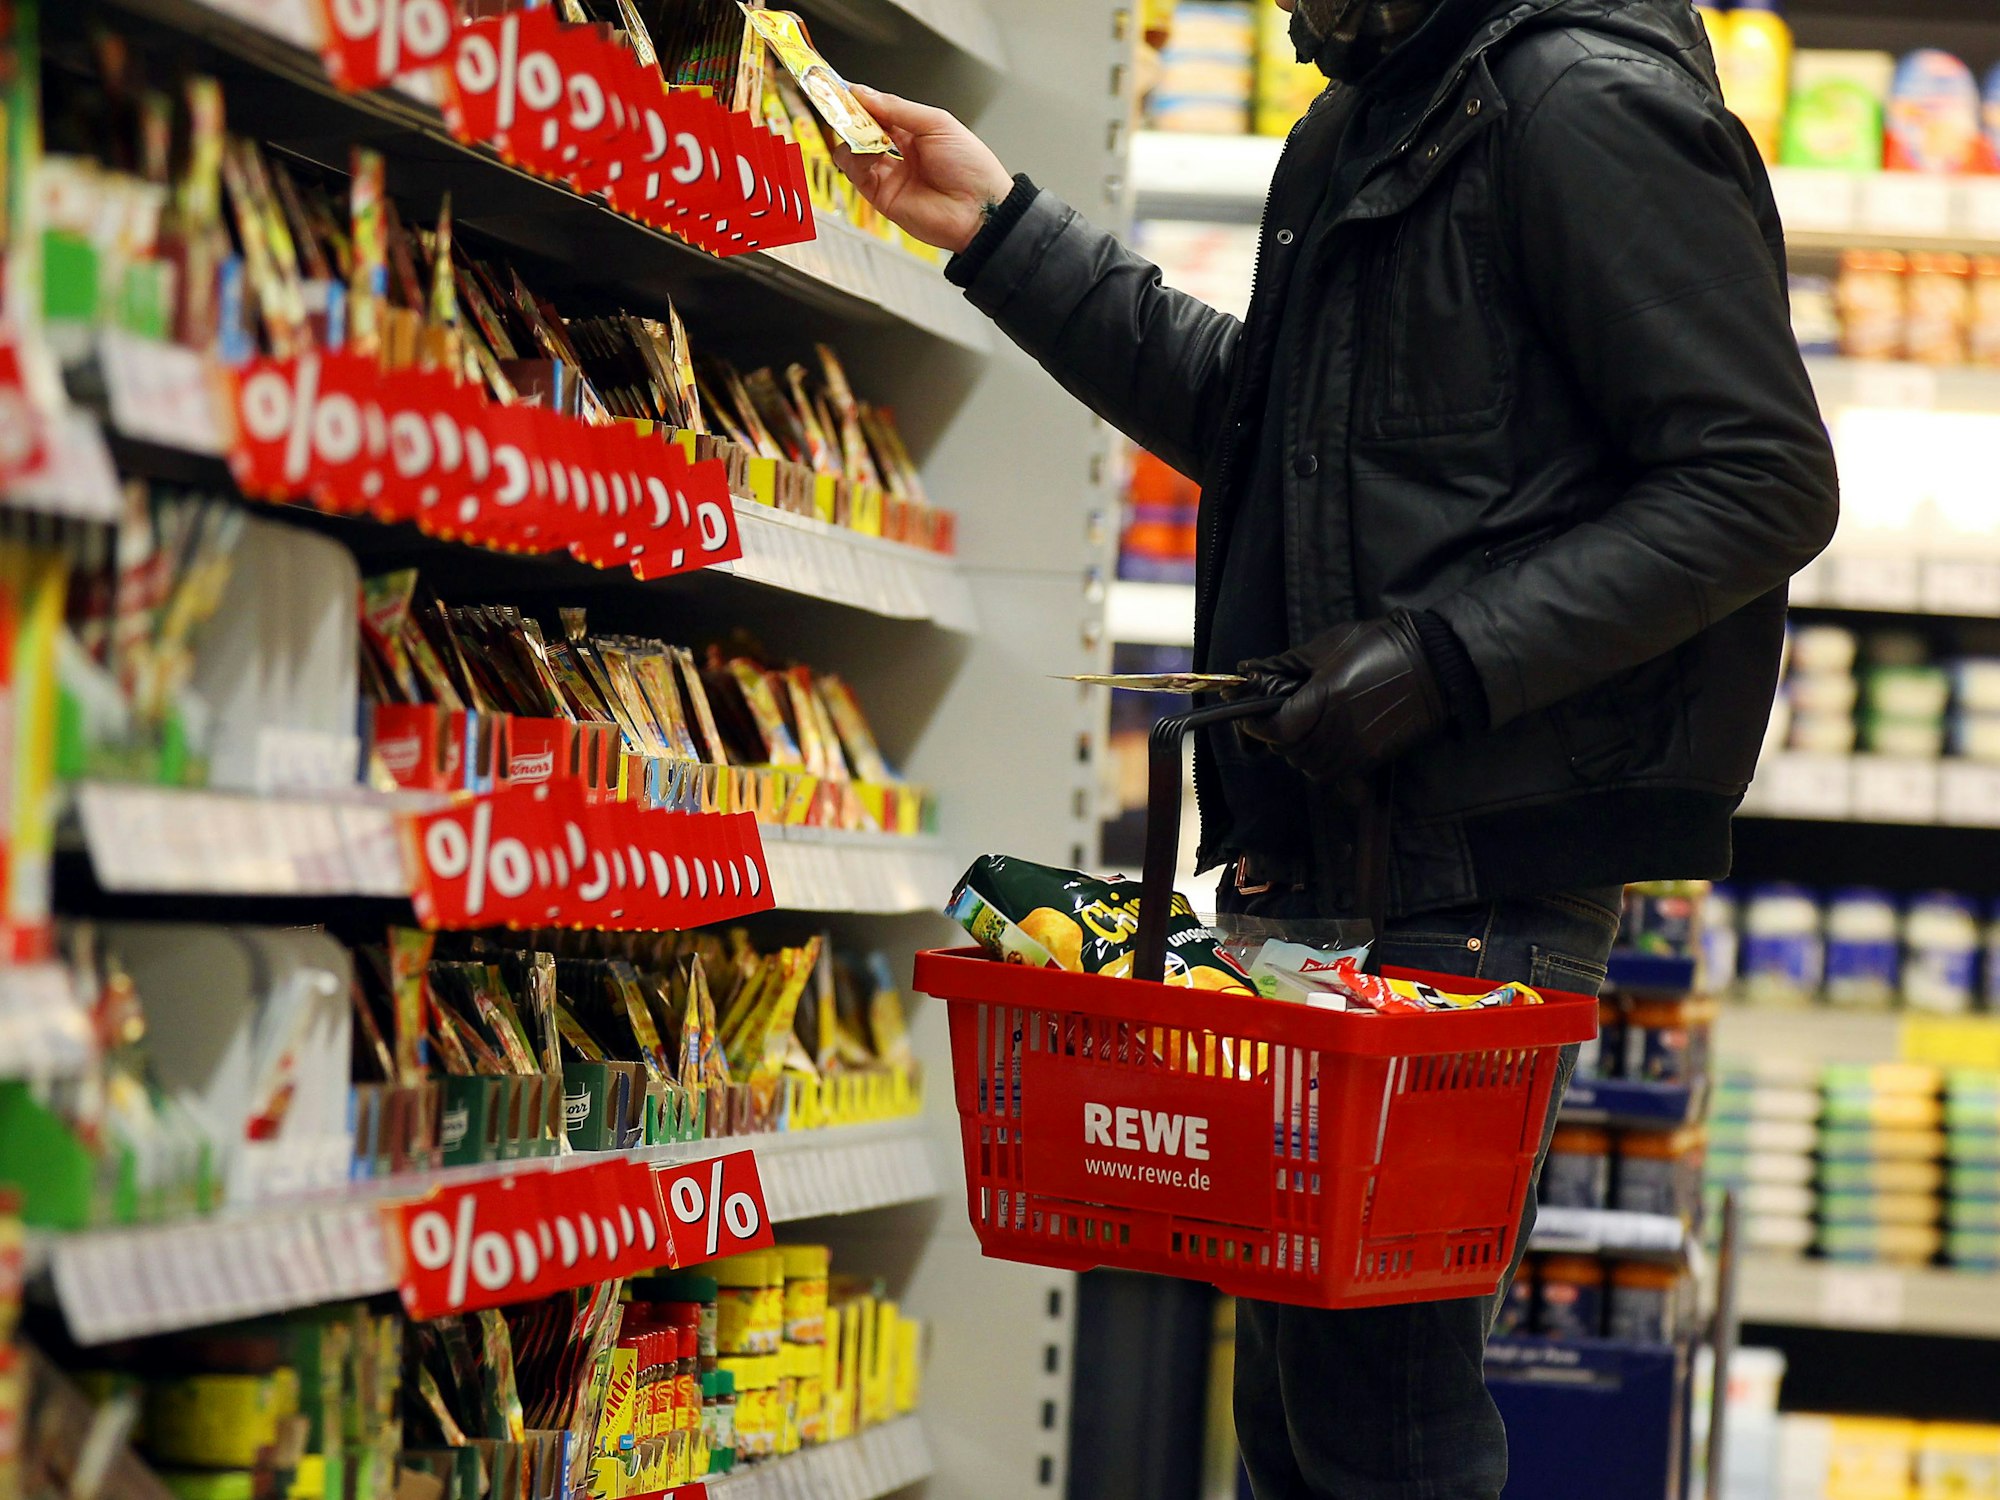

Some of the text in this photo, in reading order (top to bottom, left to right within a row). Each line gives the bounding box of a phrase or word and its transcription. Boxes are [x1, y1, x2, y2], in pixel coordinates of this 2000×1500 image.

[566, 1102, 590, 1117] orr
[1083, 1102, 1210, 1160] REWE
[1085, 1158, 1211, 1192] www.rewe.de
[670, 1160, 760, 1255] %
